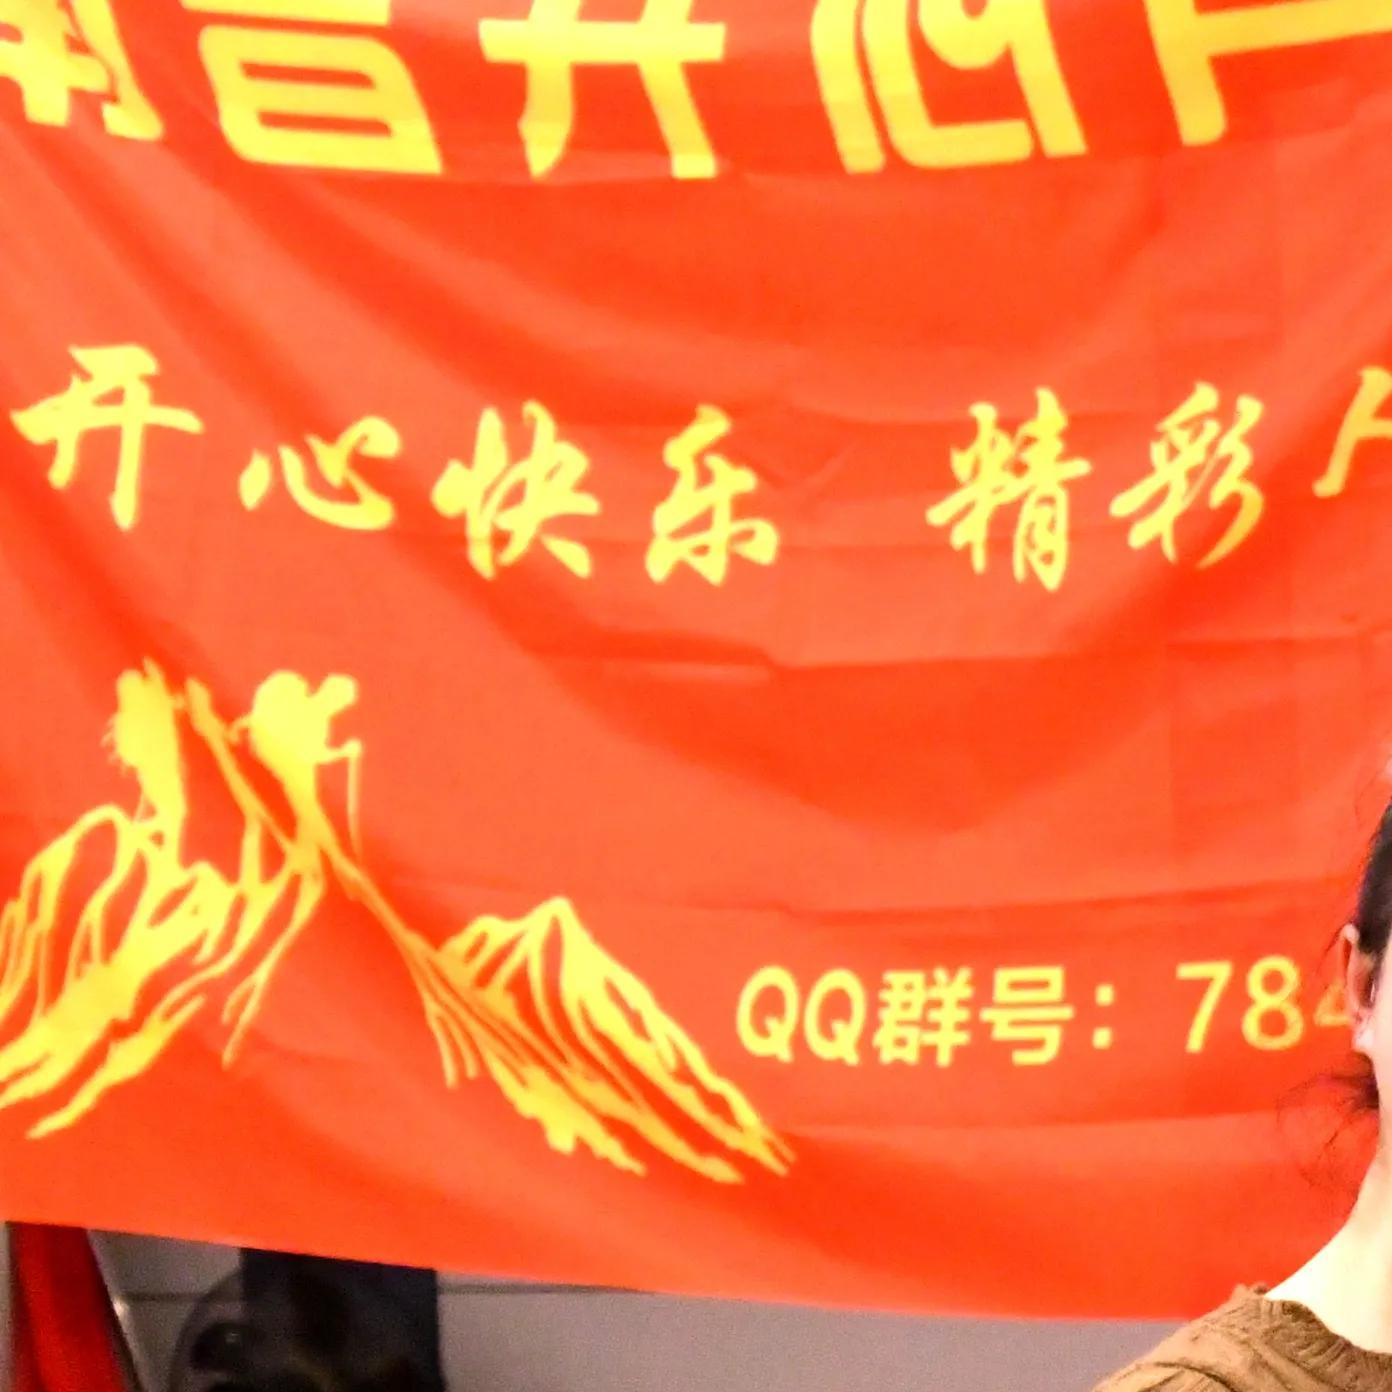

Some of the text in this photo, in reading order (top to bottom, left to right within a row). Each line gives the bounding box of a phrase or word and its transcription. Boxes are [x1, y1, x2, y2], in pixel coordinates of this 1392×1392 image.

[11, 342, 782, 587] 开心快乐
[735, 964, 1115, 1068] QQ群号：
